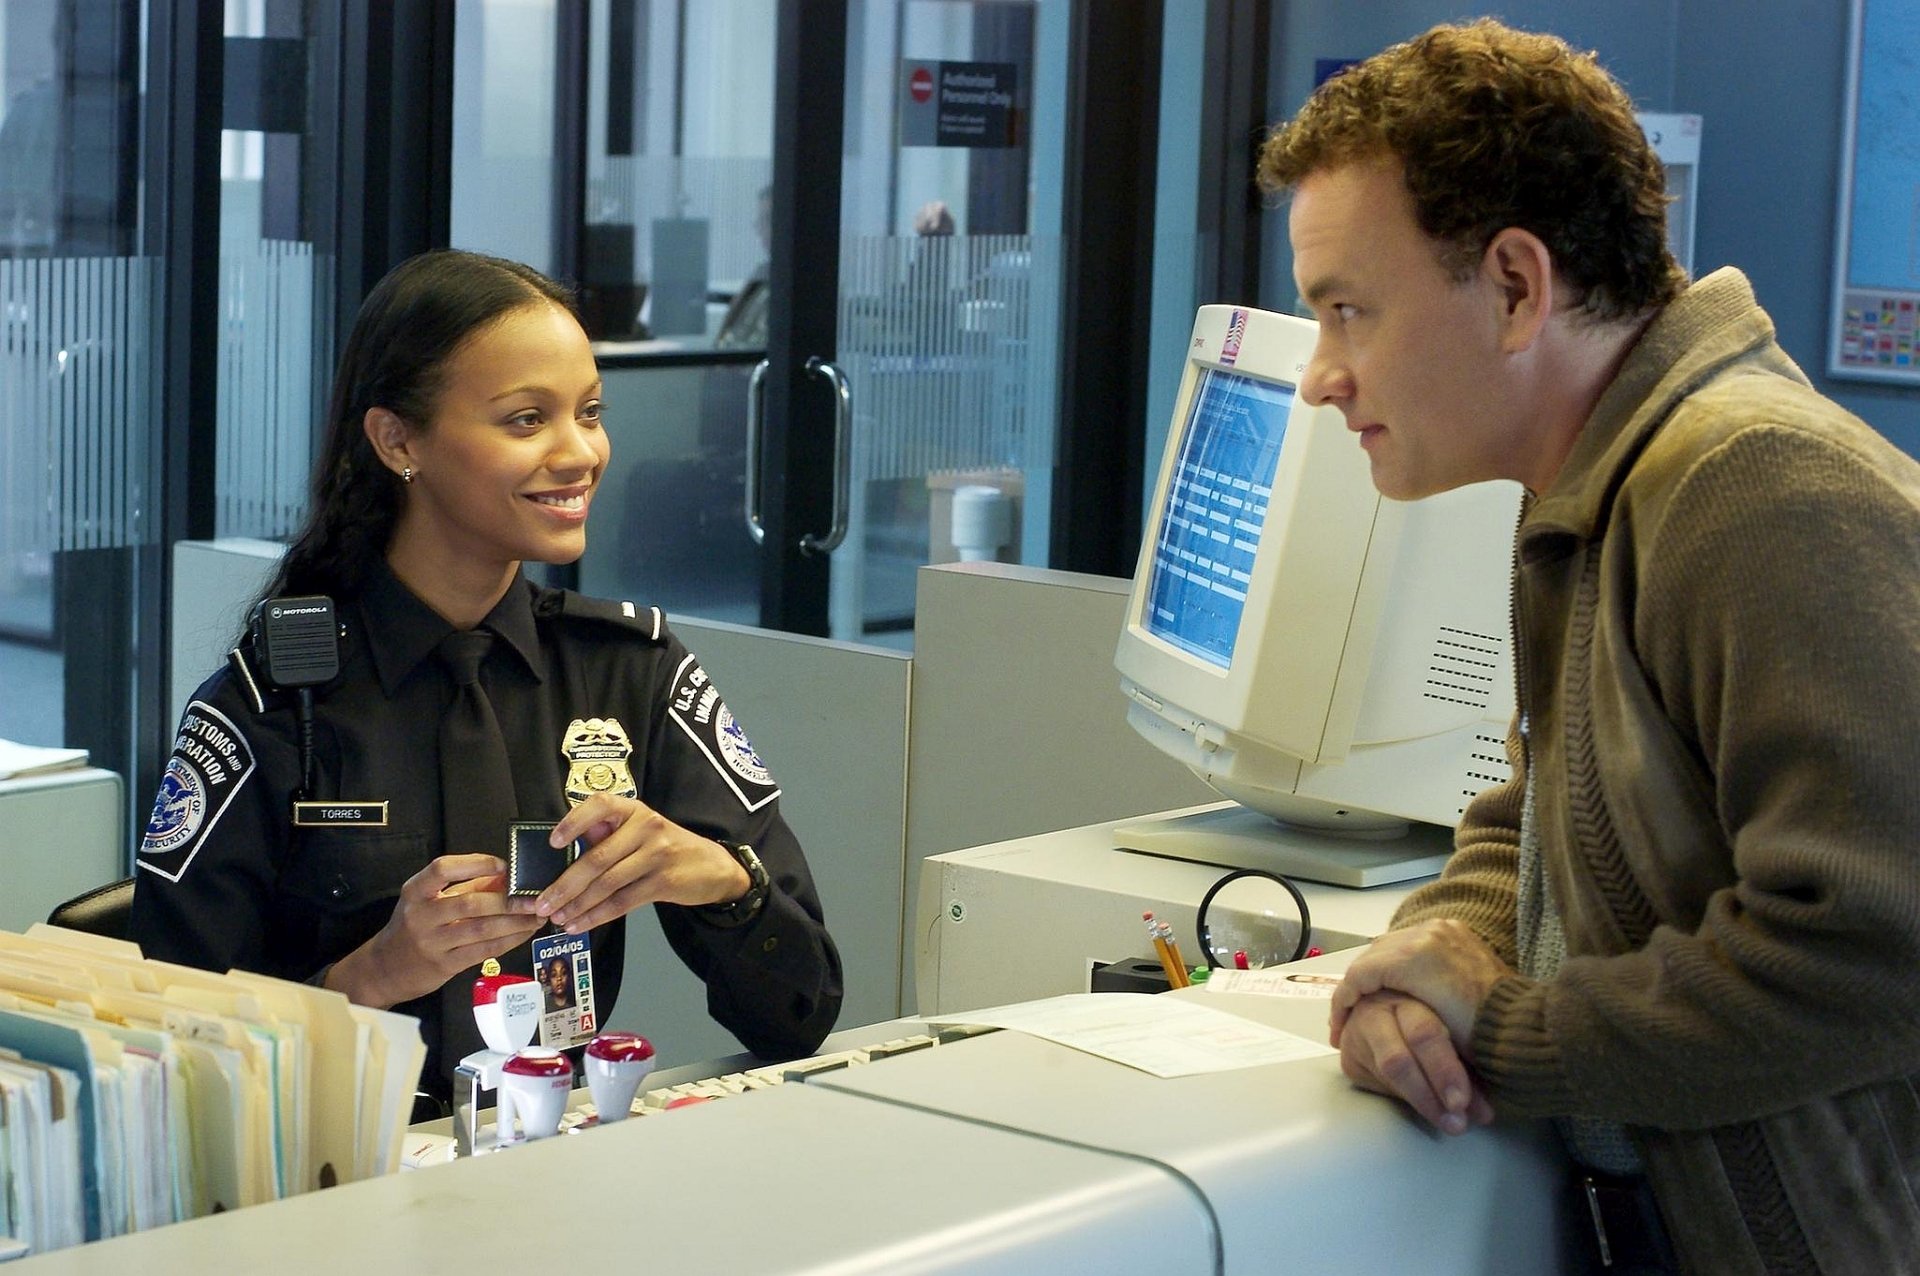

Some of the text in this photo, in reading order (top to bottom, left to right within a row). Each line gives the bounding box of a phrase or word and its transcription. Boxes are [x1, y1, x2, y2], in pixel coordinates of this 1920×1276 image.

[282, 606, 327, 615] MOTOROLA
[181, 714, 242, 771] USTOMS AND
[176, 735, 227, 785] GRATION
[320, 809, 362, 819] TORRES
[539, 940, 584, 959] 02/04/05
